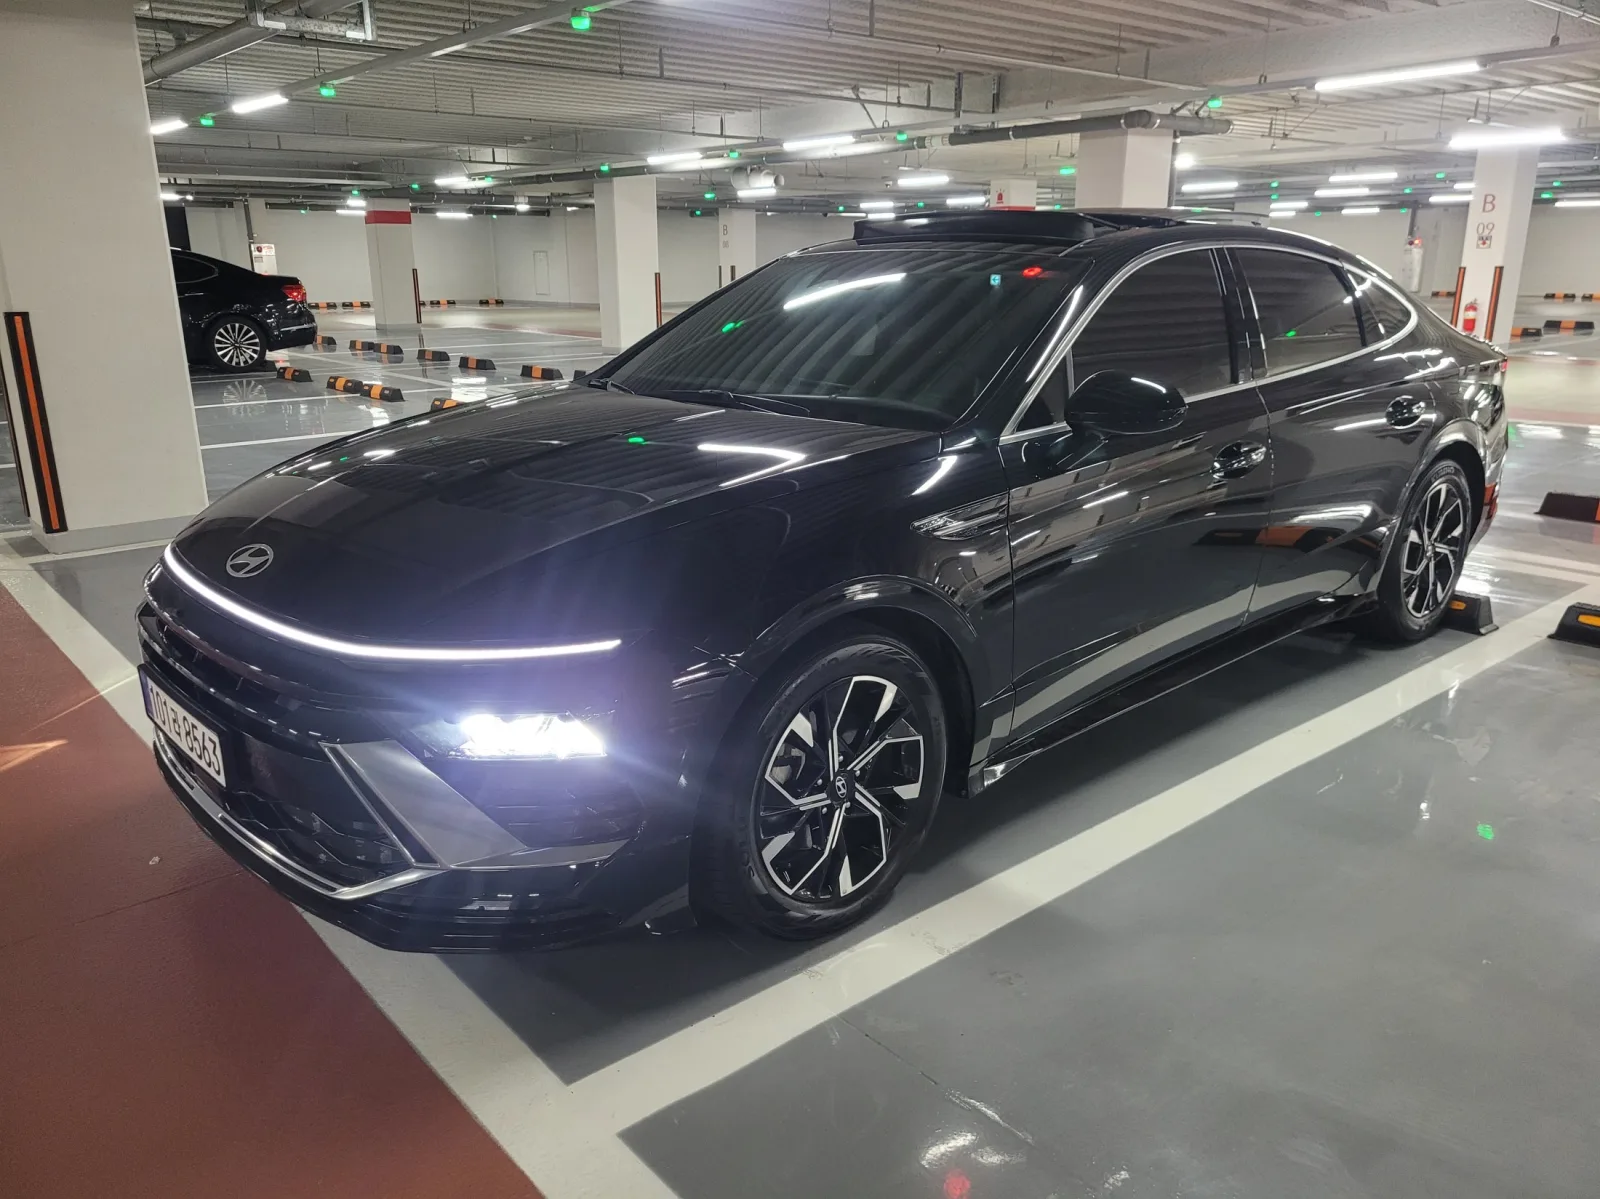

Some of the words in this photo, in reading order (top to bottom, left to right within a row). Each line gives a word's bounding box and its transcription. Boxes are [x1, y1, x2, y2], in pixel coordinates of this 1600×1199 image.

[1482, 194, 1496, 213] B
[722, 224, 728, 236] B
[1476, 222, 1495, 235] 09
[183, 715, 221, 776] 8563
